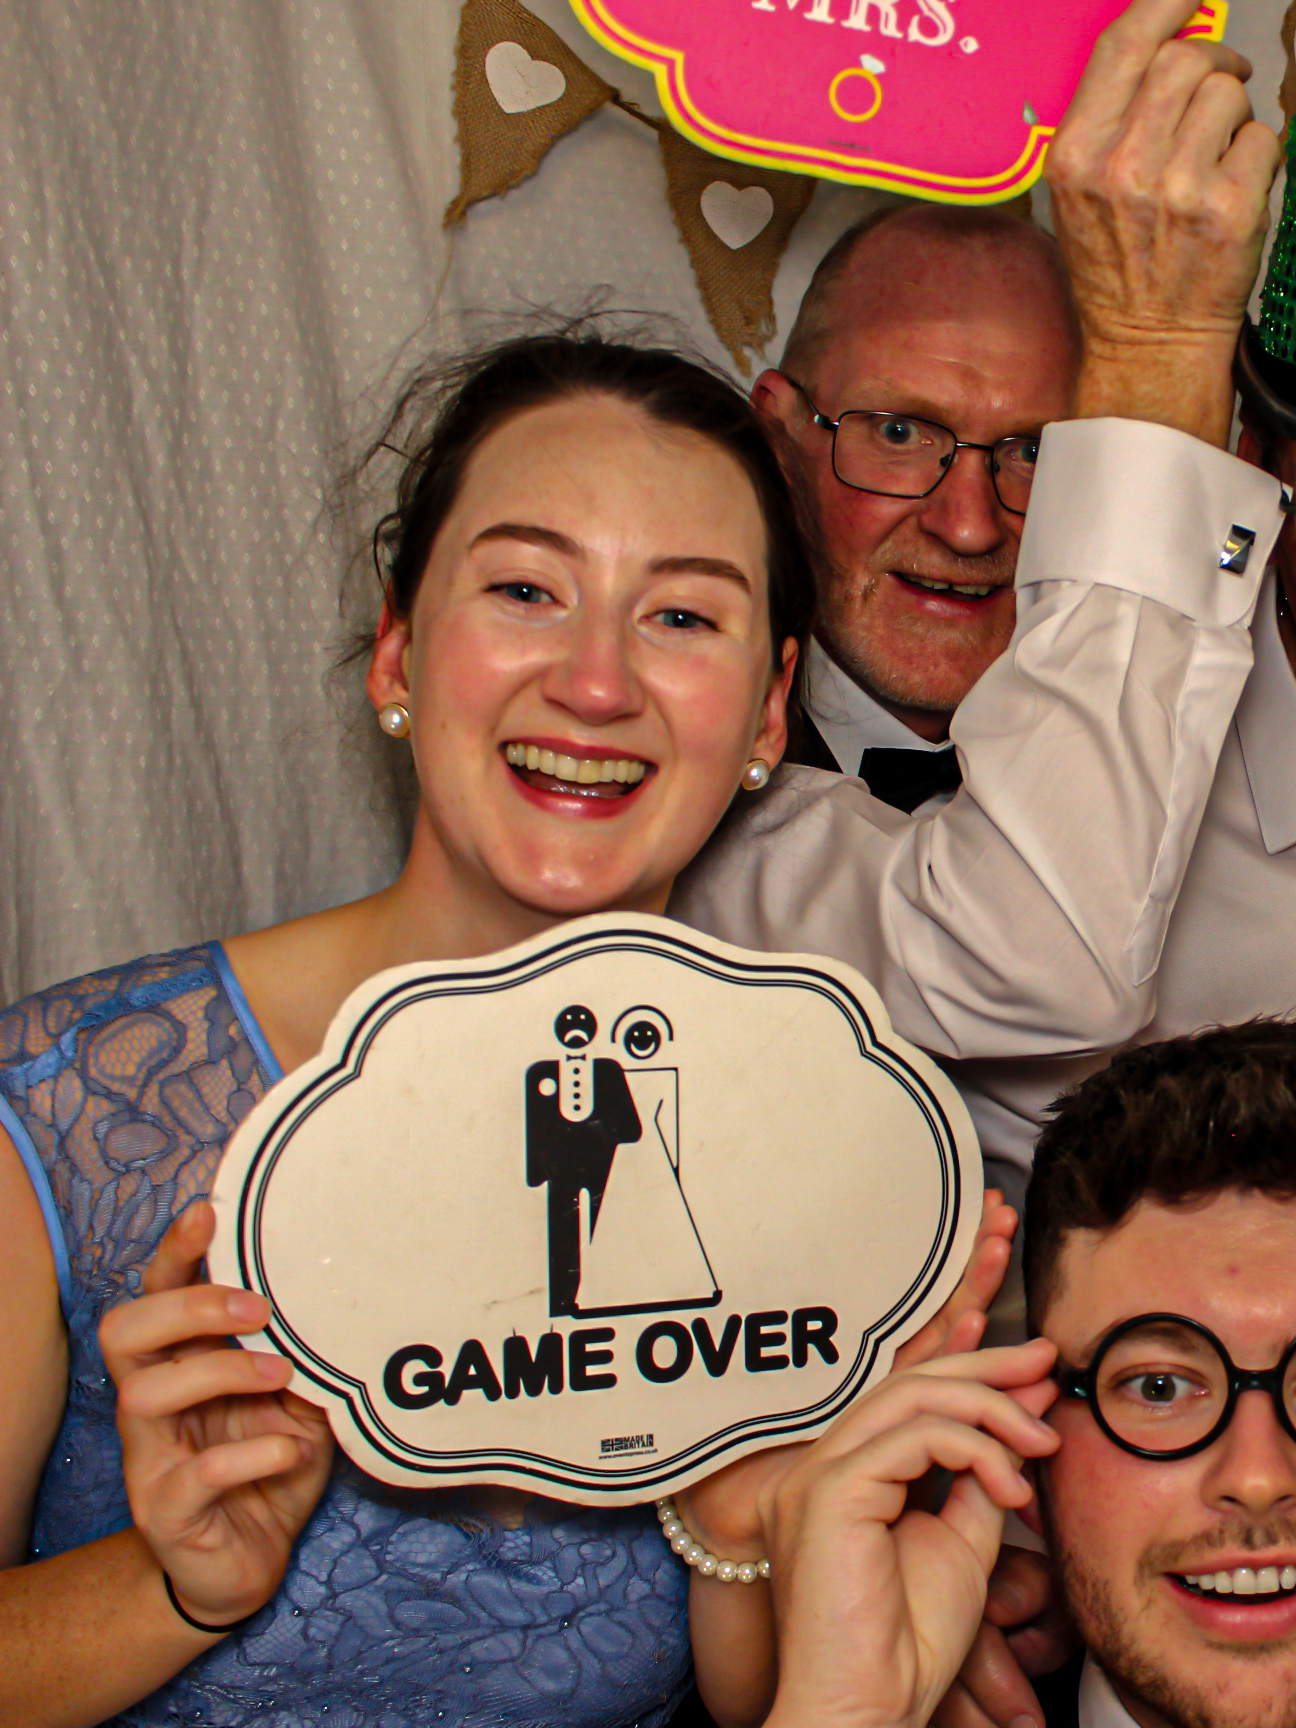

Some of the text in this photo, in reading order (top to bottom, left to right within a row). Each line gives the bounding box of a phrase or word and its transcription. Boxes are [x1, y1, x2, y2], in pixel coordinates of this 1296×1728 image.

[751, 0, 979, 54] RS.
[384, 1306, 840, 1410] GAME OVER
[624, 1433, 654, 1444] MADE IN
[624, 1440, 654, 1450] BRITAIN
